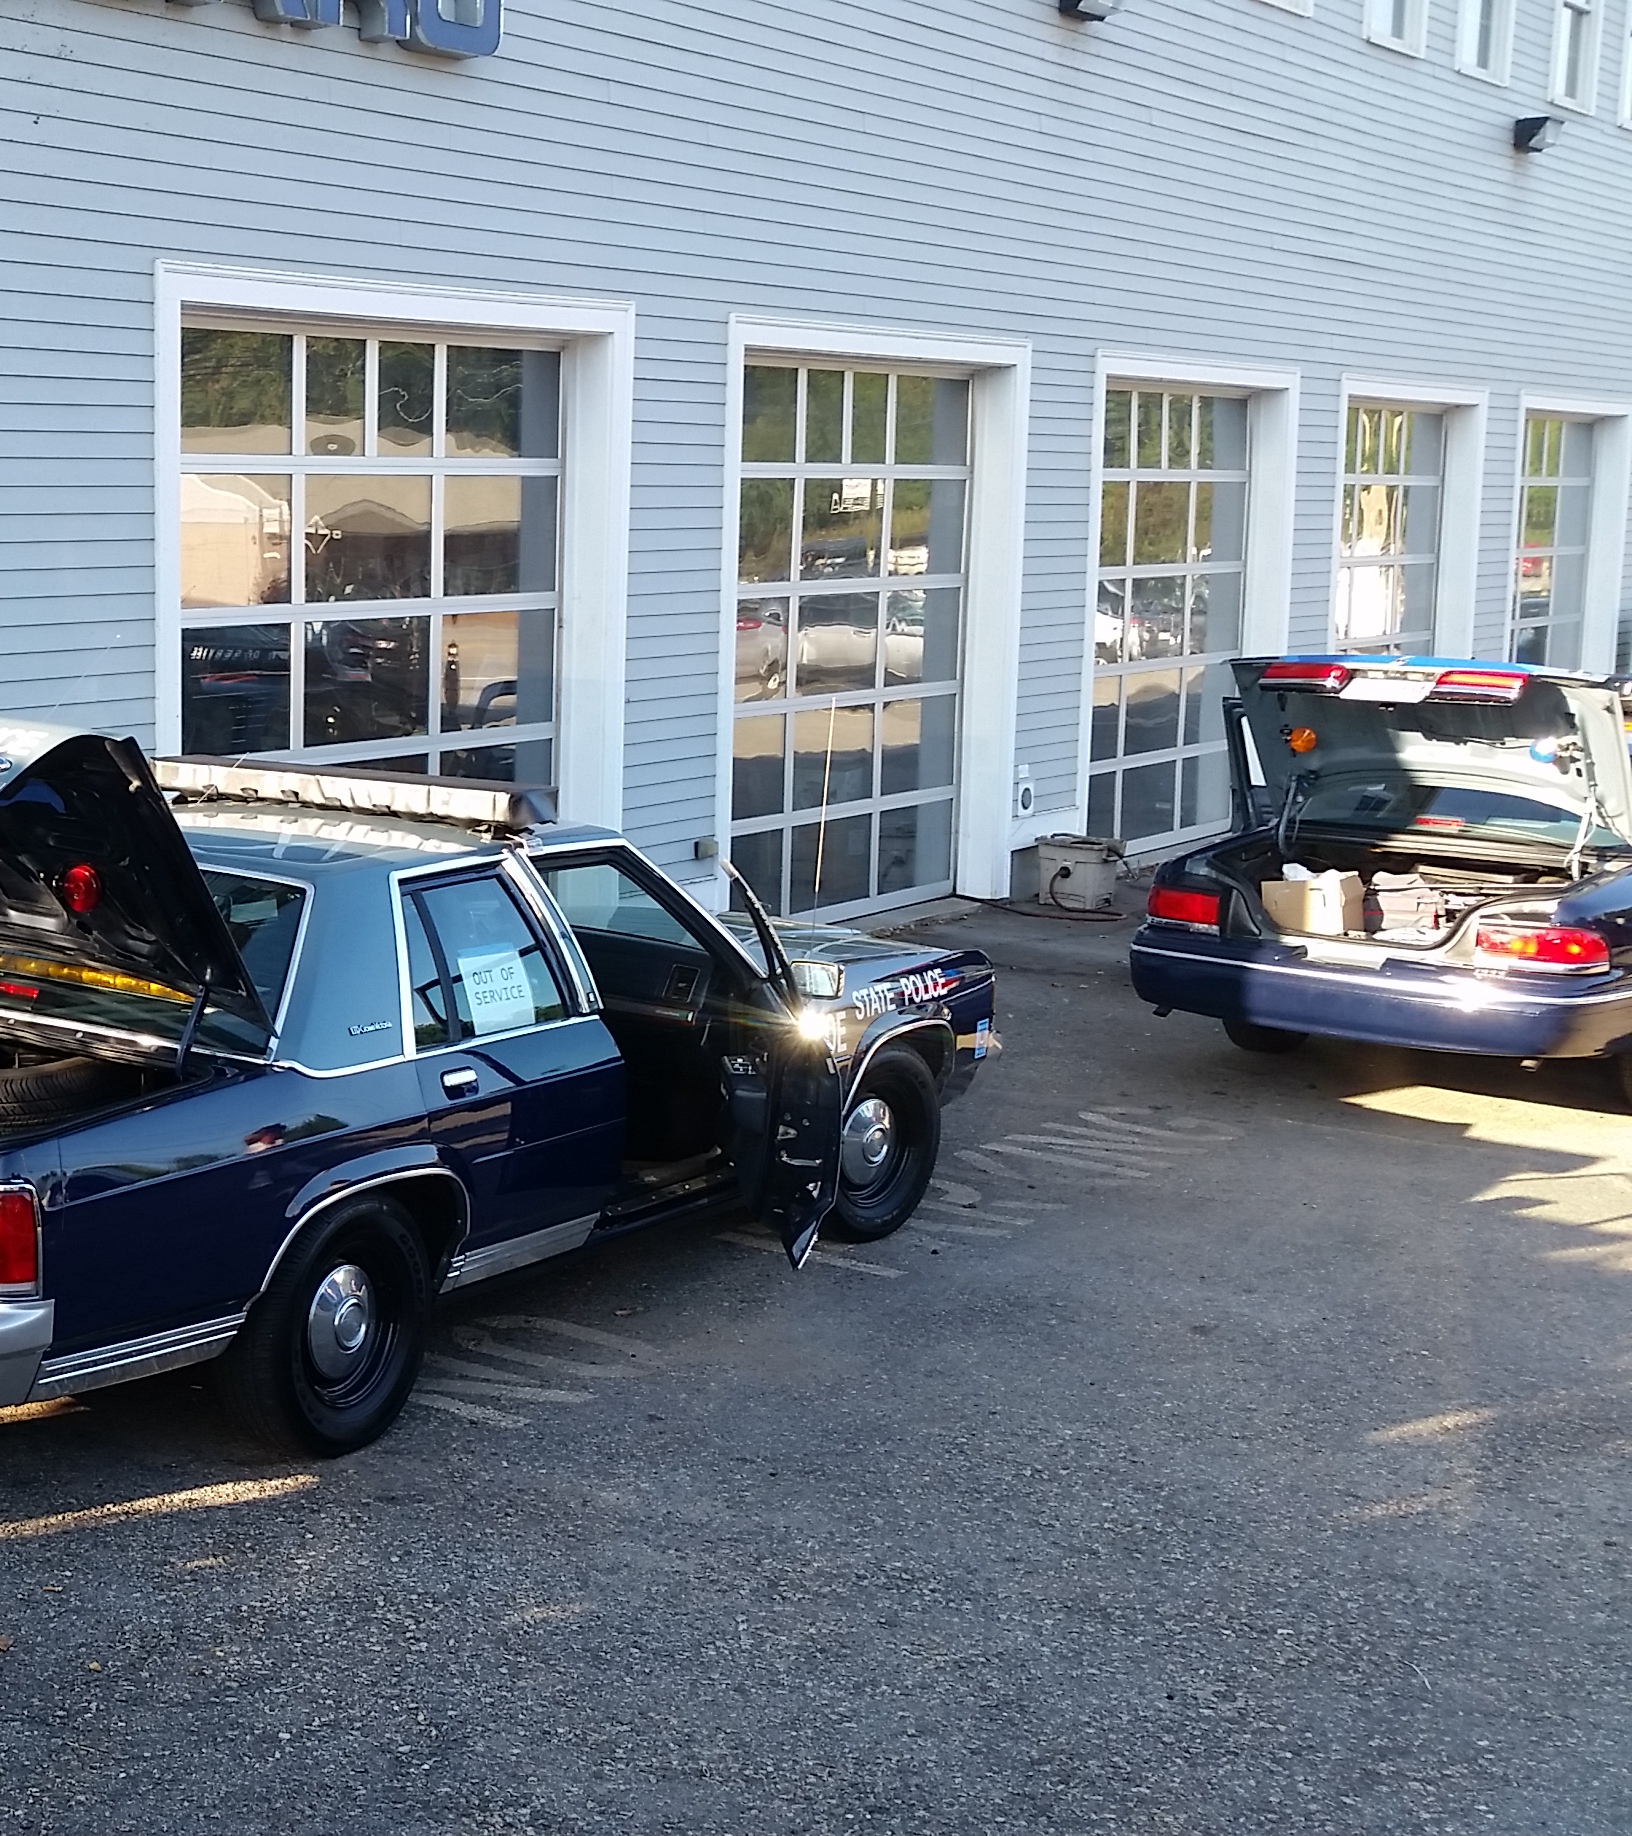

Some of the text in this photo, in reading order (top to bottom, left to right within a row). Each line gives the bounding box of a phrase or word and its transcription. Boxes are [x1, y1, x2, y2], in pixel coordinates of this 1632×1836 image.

[472, 966, 515, 985] OUT OF
[474, 985, 525, 1006] SERVICE
[852, 968, 948, 1021] STATE POLICE
